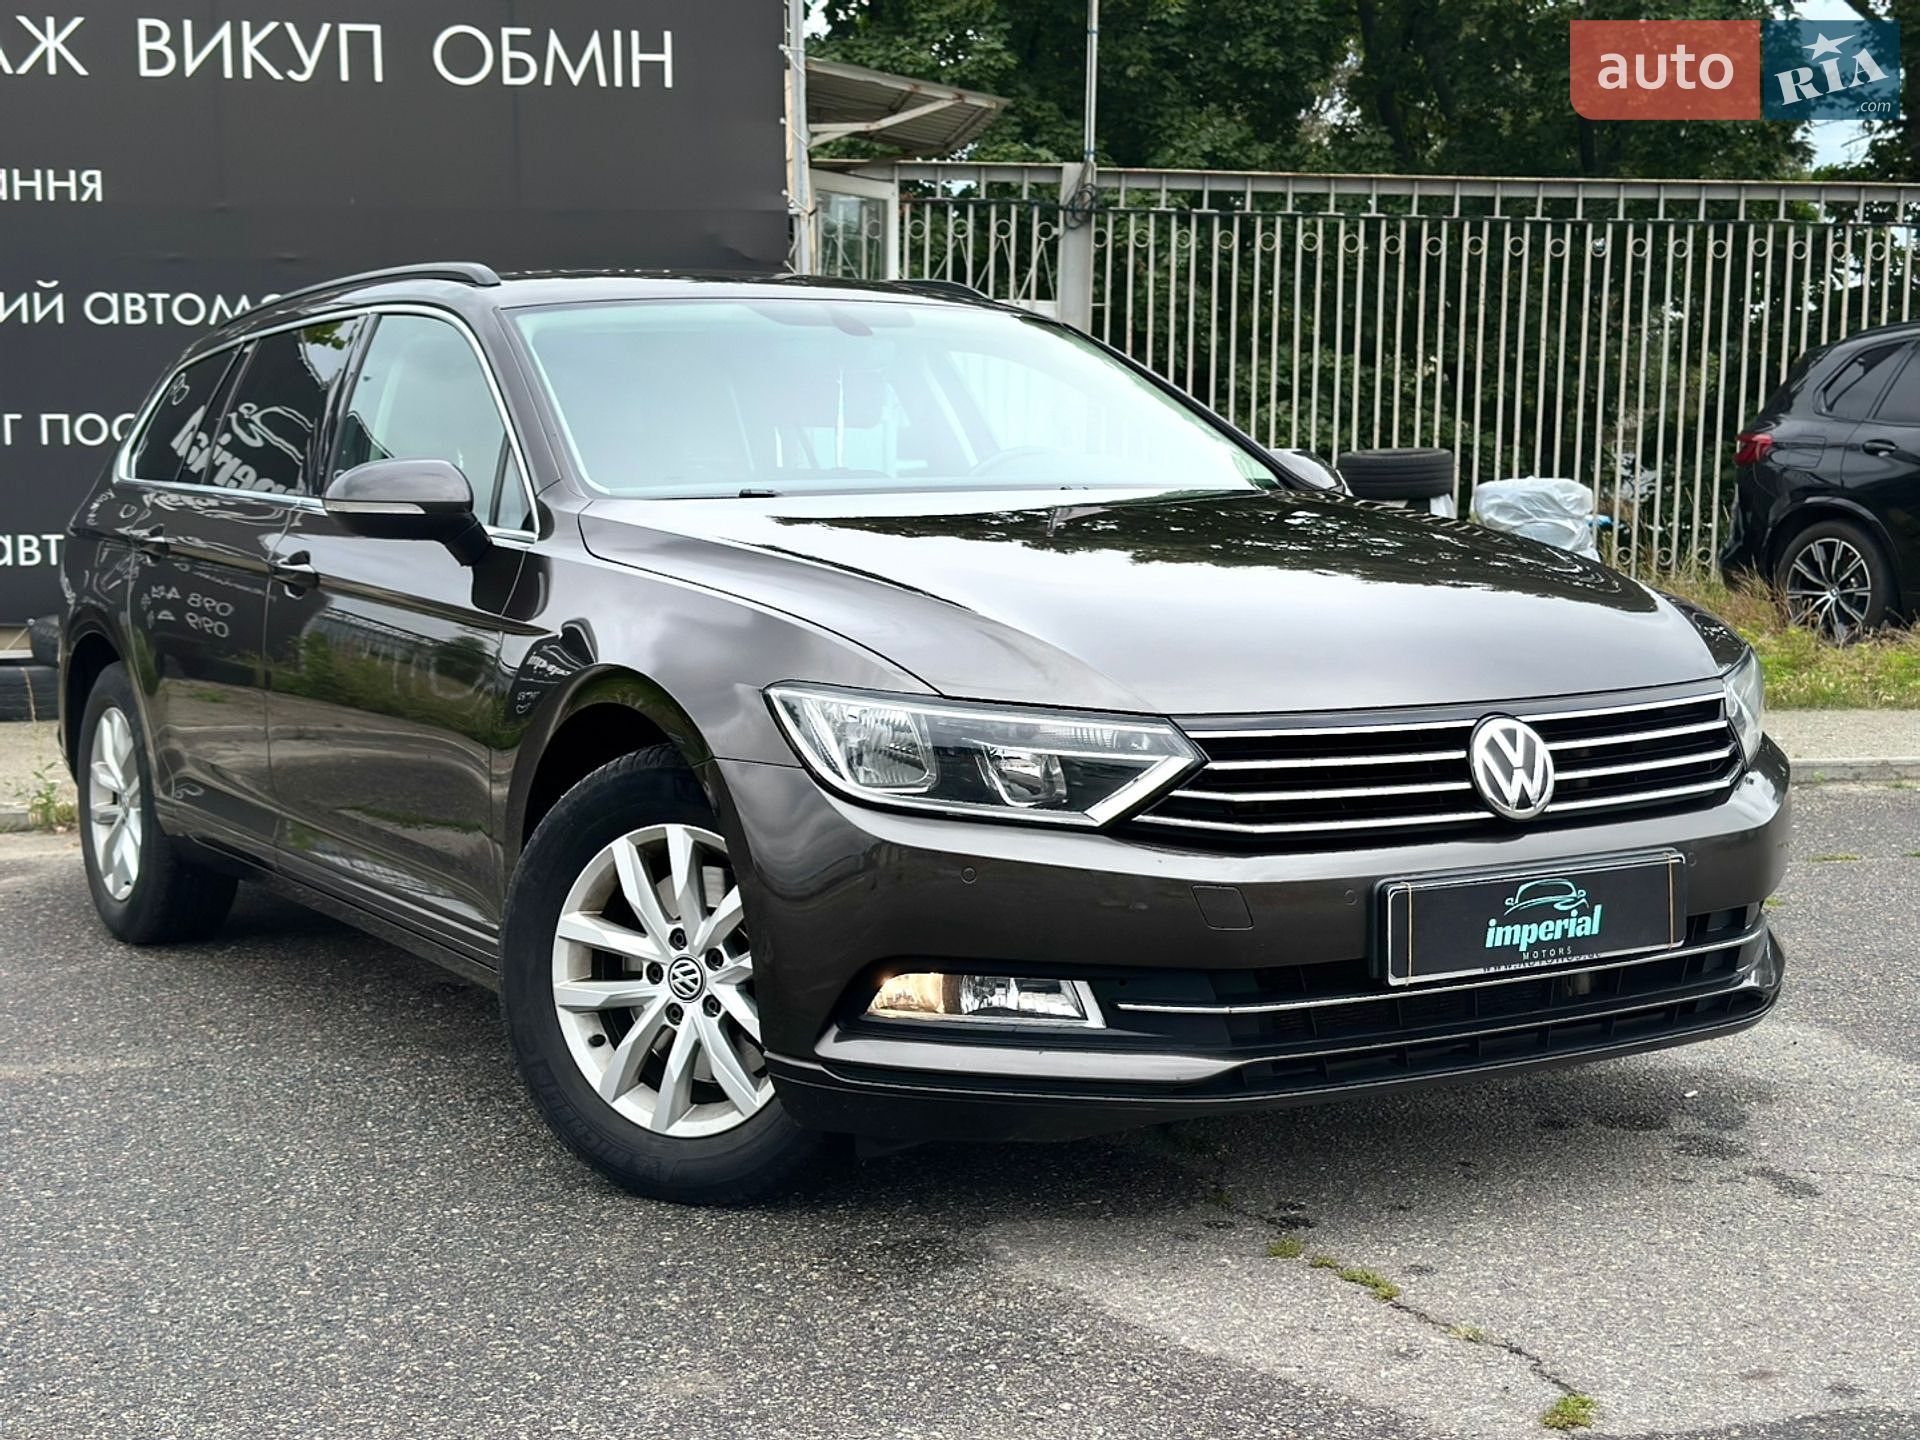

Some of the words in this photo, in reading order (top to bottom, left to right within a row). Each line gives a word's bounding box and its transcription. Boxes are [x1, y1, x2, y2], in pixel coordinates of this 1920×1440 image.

[0, 16, 89, 76] Ж
[137, 17, 383, 83] ВИКУП
[433, 24, 673, 88] ОБМІН
[0, 168, 103, 202] ння
[84, 291, 281, 326] автом
[1485, 904, 1603, 951] imperial
[1522, 946, 1572, 960] MOTORS
